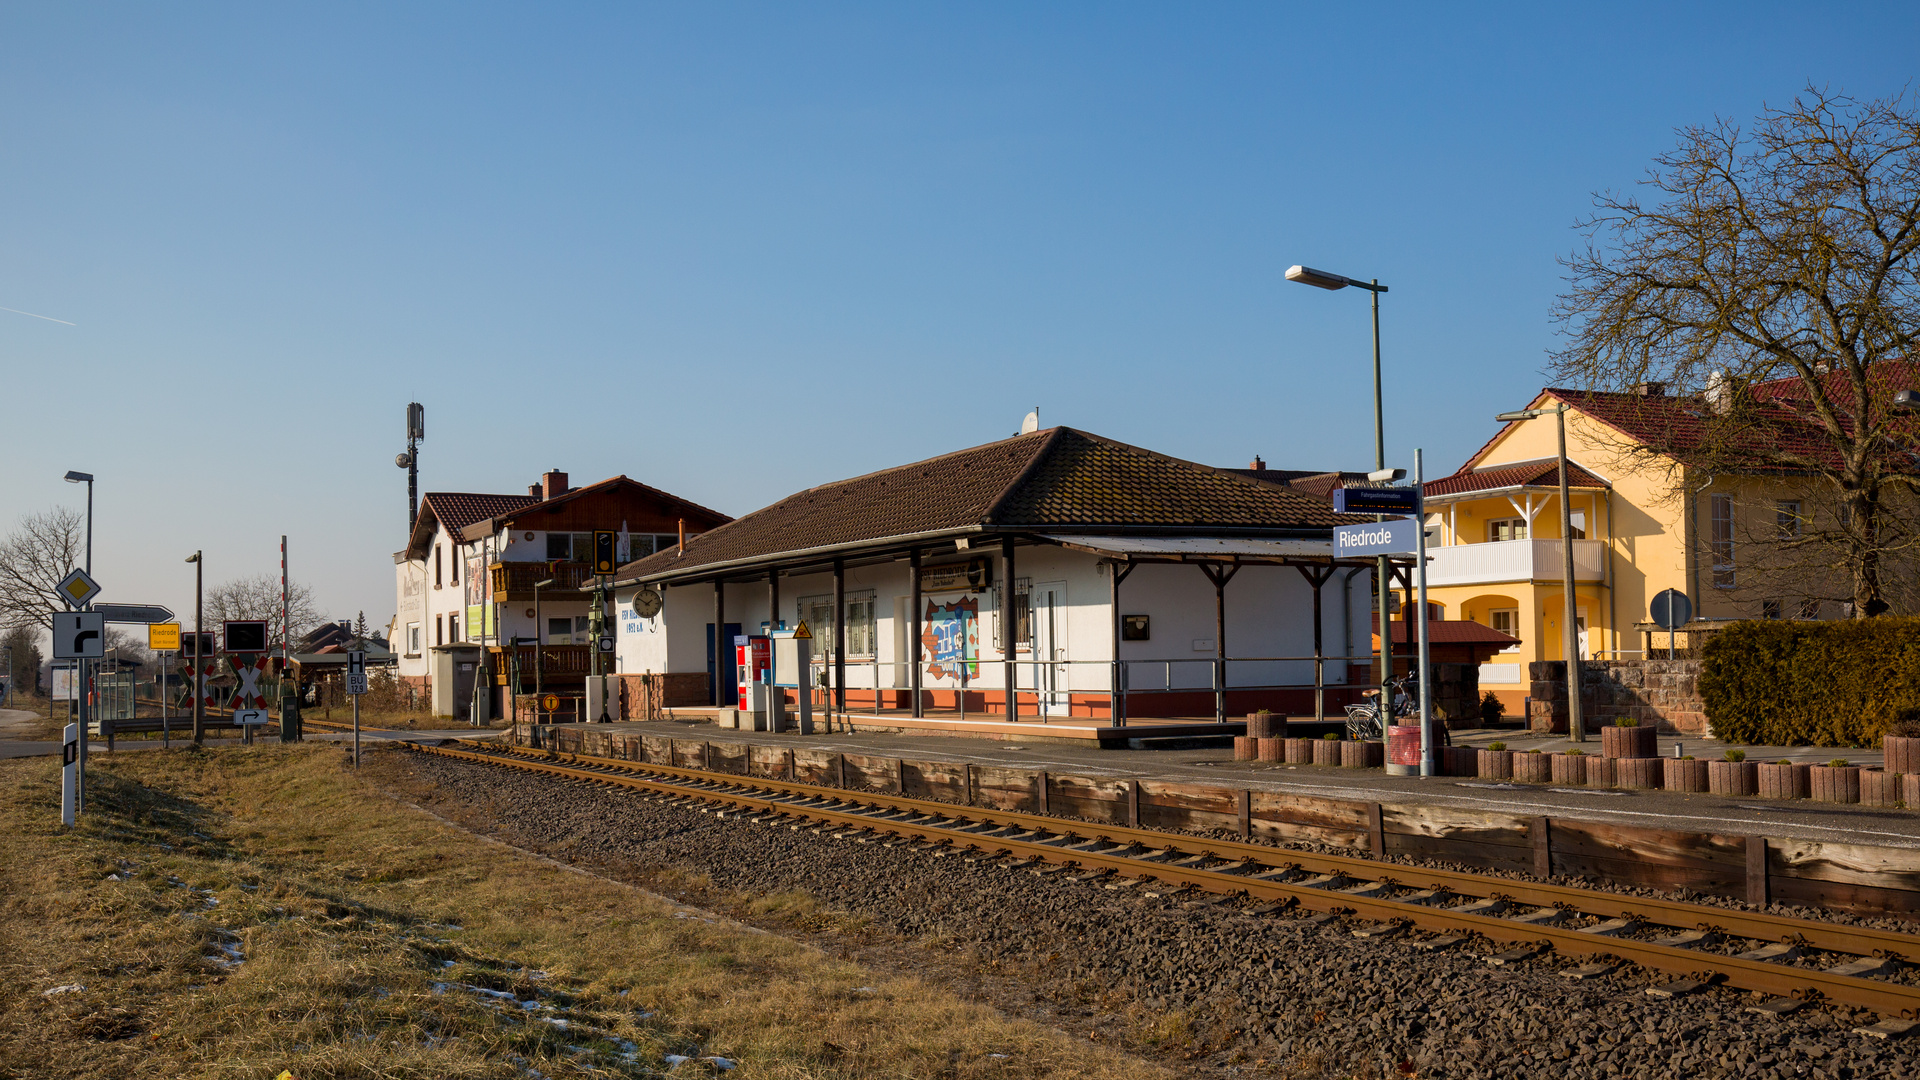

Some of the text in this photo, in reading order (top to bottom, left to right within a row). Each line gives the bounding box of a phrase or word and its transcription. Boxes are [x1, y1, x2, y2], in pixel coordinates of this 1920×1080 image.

[1339, 527, 1392, 548] Riedrode
[933, 565, 967, 580] RIEDRODE
[152, 628, 177, 636] Riedrode
[349, 653, 363, 673] H
